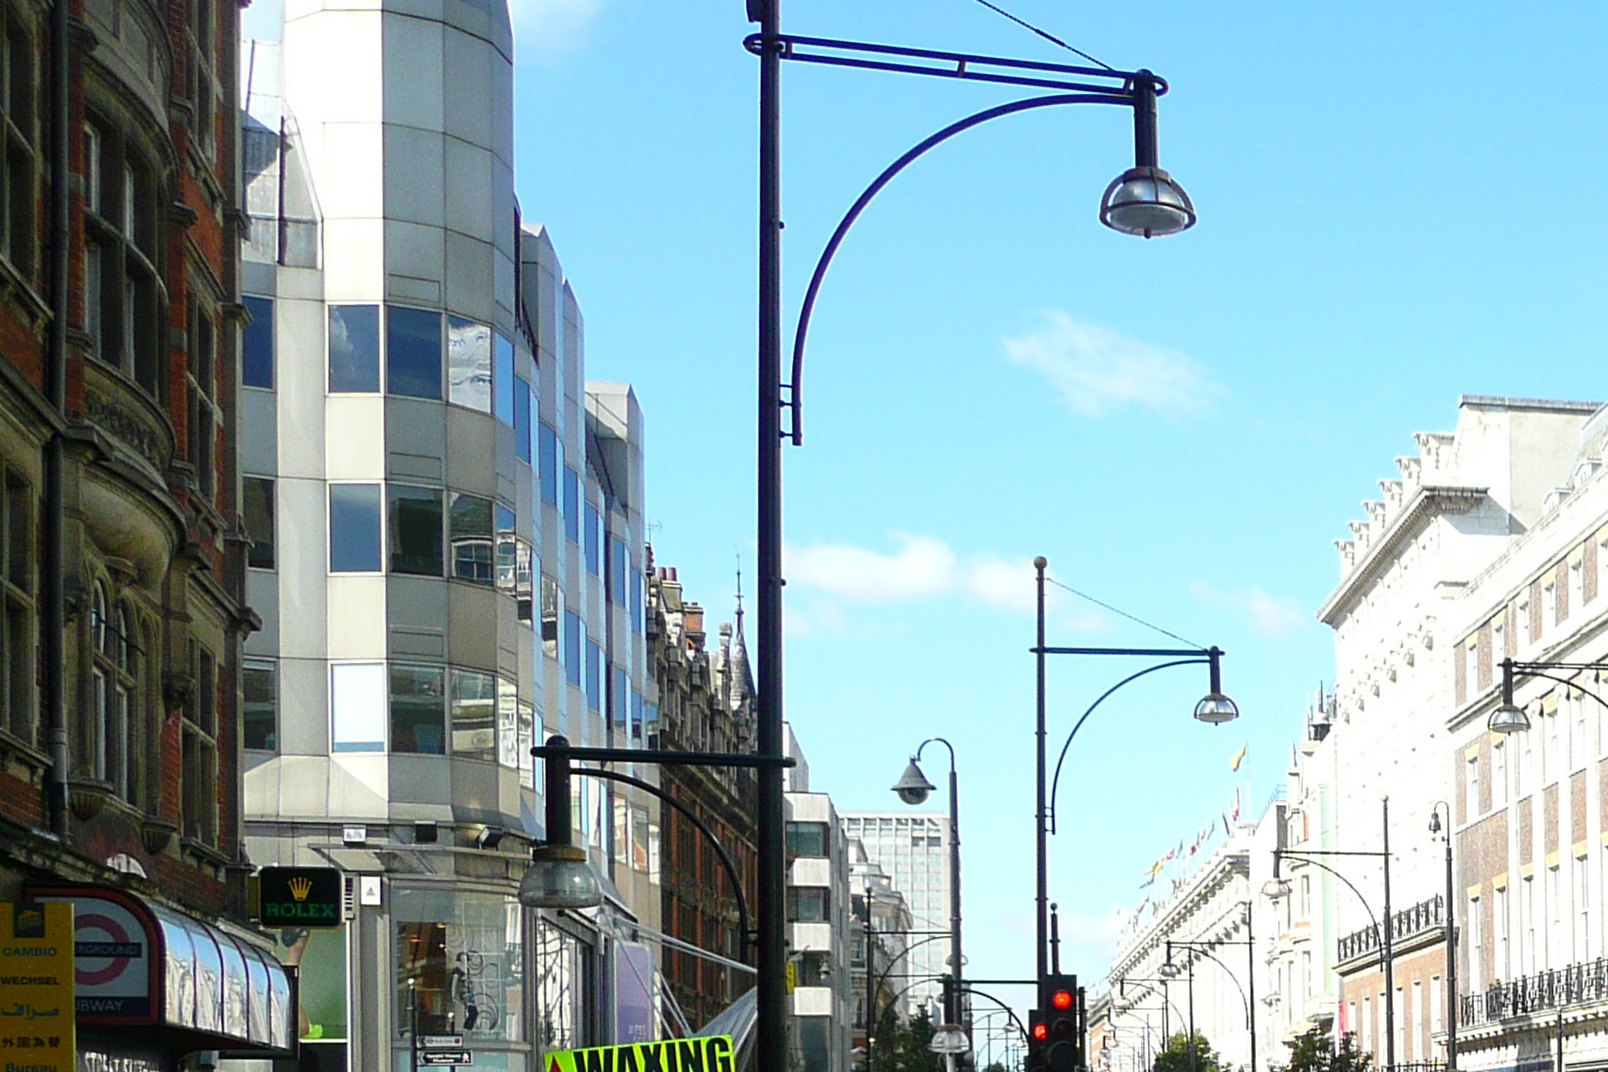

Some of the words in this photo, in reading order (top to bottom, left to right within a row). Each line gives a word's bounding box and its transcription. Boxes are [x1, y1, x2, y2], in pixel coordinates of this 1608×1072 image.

[265, 902, 336, 918] ROLEX
[3, 947, 57, 957] CAMBIO
[1, 976, 60, 986] WECHSEL
[5, 1063, 57, 1072] Bureau
